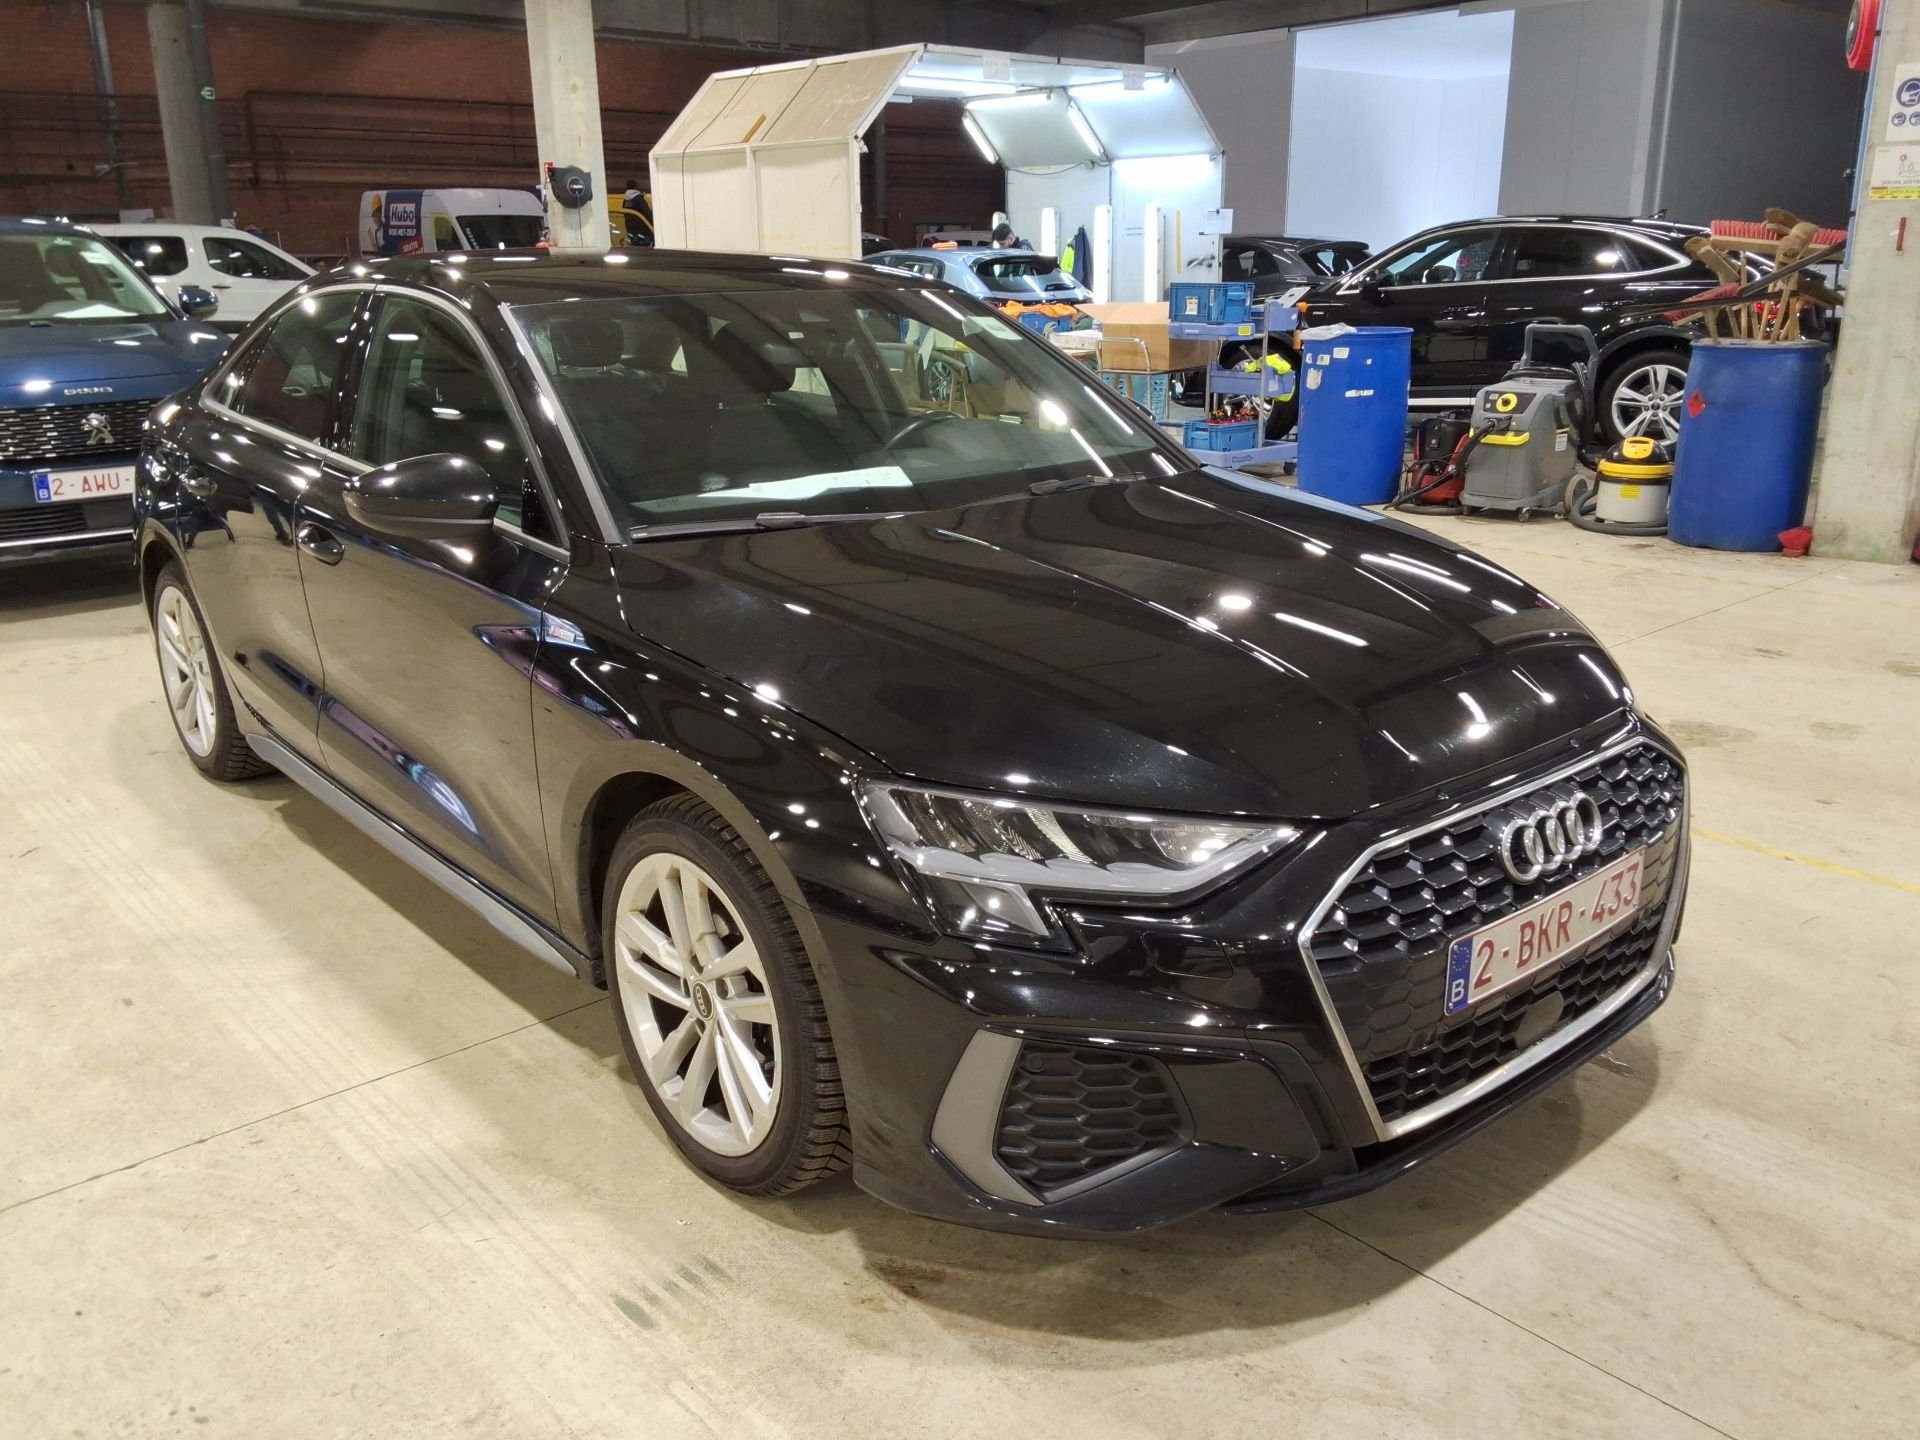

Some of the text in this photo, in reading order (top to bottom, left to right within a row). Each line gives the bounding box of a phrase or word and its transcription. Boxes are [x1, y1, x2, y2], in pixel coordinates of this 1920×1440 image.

[391, 206, 414, 222] Hubo
[1473, 861, 1640, 990] 2-BKR-433
[1451, 978, 1465, 1003] B
